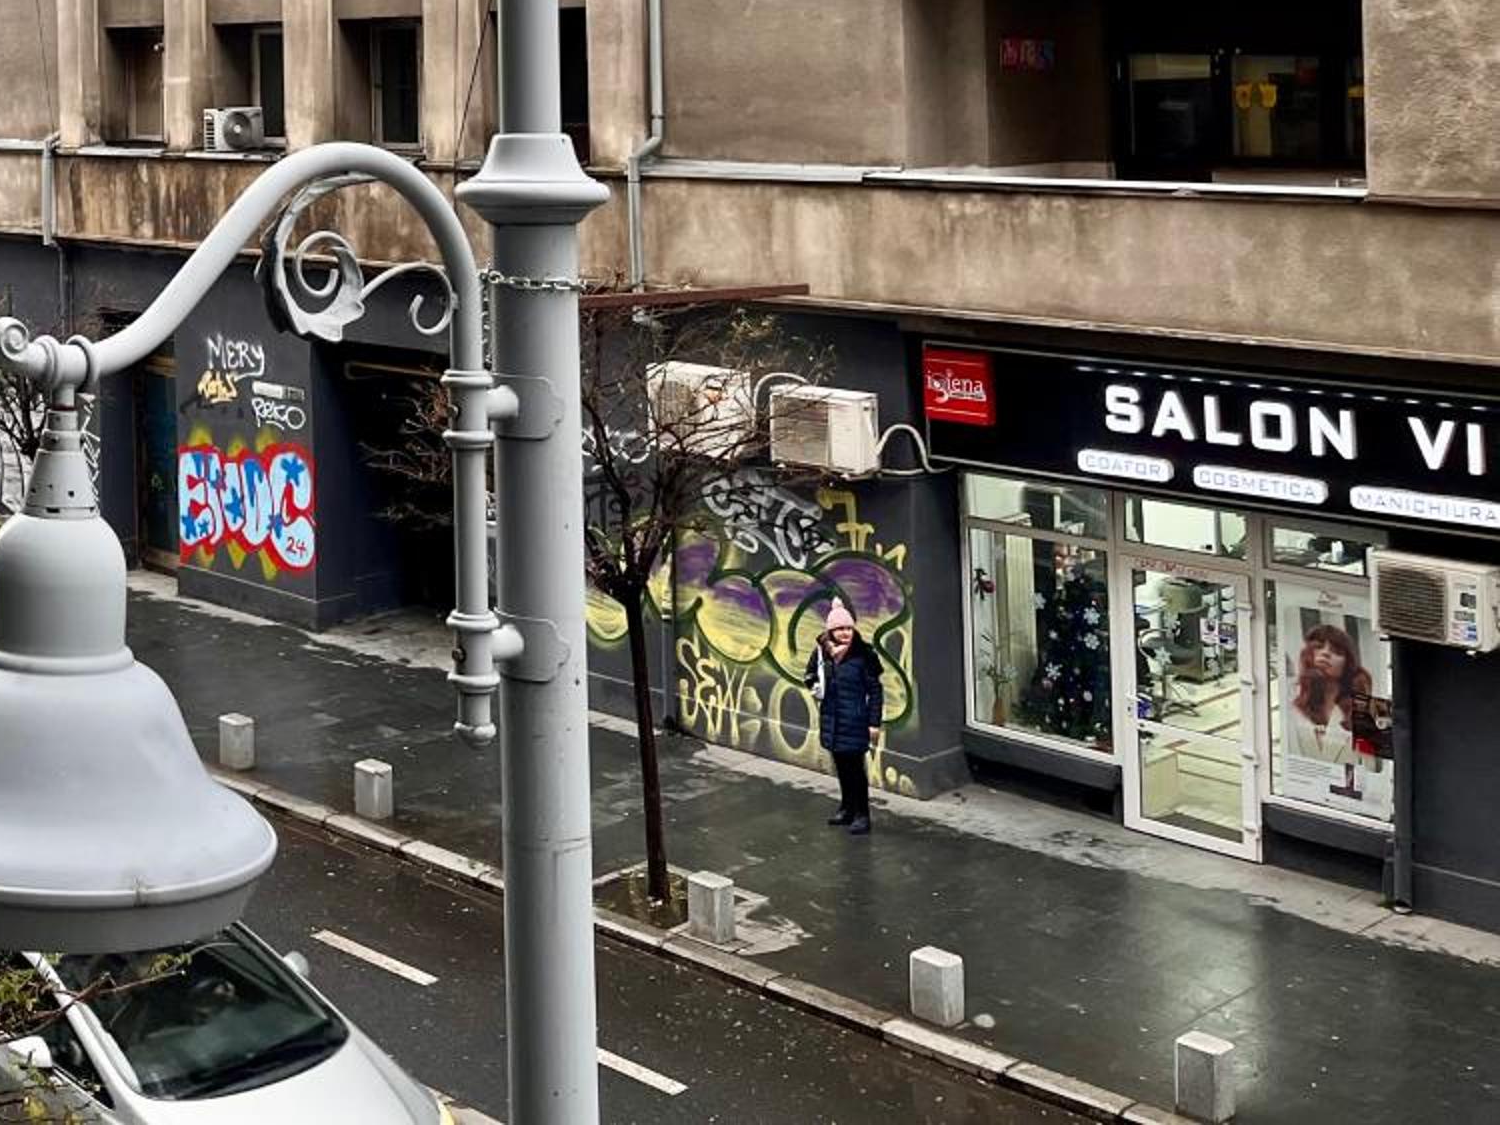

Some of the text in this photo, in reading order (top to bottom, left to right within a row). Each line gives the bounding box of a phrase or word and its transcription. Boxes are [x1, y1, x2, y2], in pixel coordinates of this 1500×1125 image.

[1104, 383, 1487, 476] SALON VI
[1083, 453, 1162, 477] COAFOR
[1198, 469, 1317, 499] COSMETICA
[1356, 492, 1498, 521] MANICHIURA
